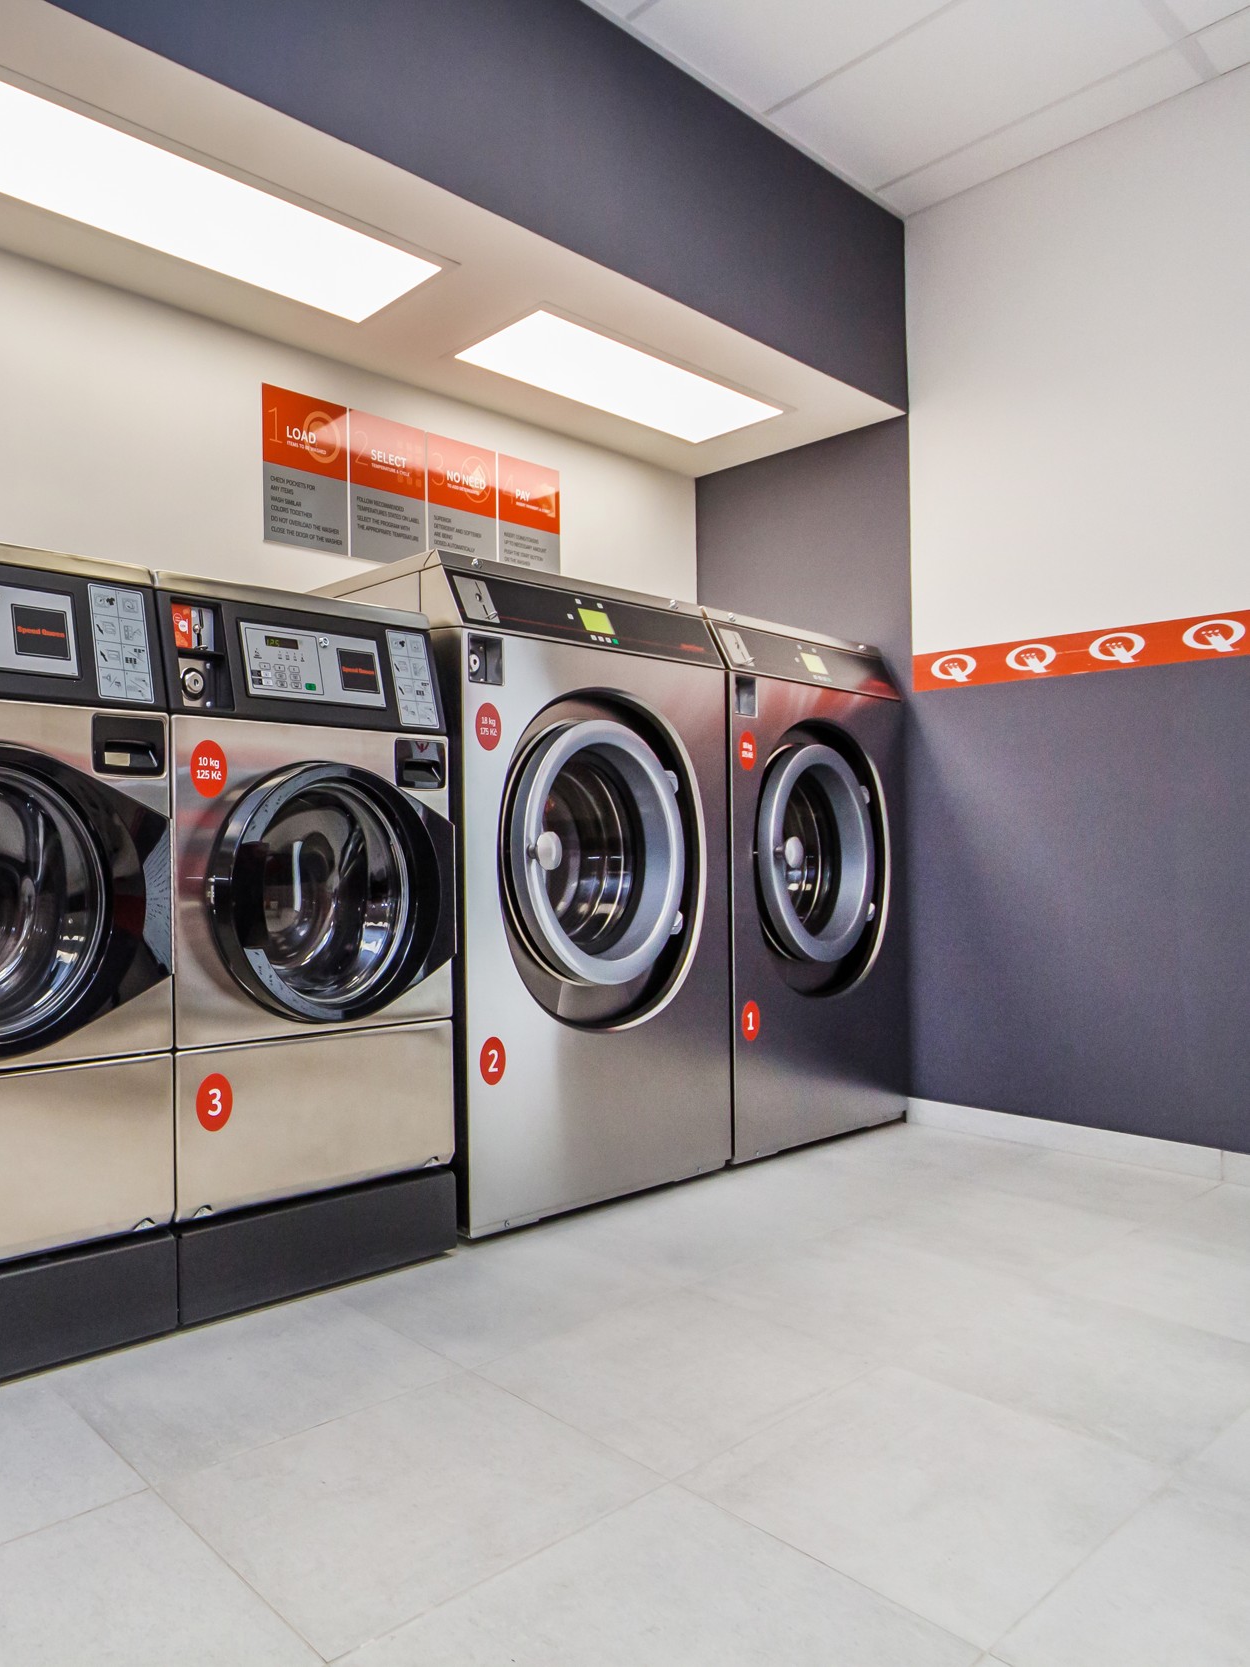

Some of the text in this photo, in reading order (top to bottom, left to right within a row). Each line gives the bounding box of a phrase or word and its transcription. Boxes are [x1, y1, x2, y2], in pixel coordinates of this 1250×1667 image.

[268, 407, 282, 443] 1
[287, 426, 316, 444] LOAD
[355, 431, 368, 465] 2
[371, 449, 406, 468] SELECT
[432, 452, 444, 485] 3
[447, 470, 460, 483] NO
[462, 474, 485, 490] NEED
[516, 489, 530, 502] PAY
[199, 757, 220, 769] 10 kg
[196, 770, 222, 780] 125 Kč
[747, 1012, 754, 1030] 1
[488, 1050, 498, 1072] 2
[208, 1088, 222, 1116] 3
